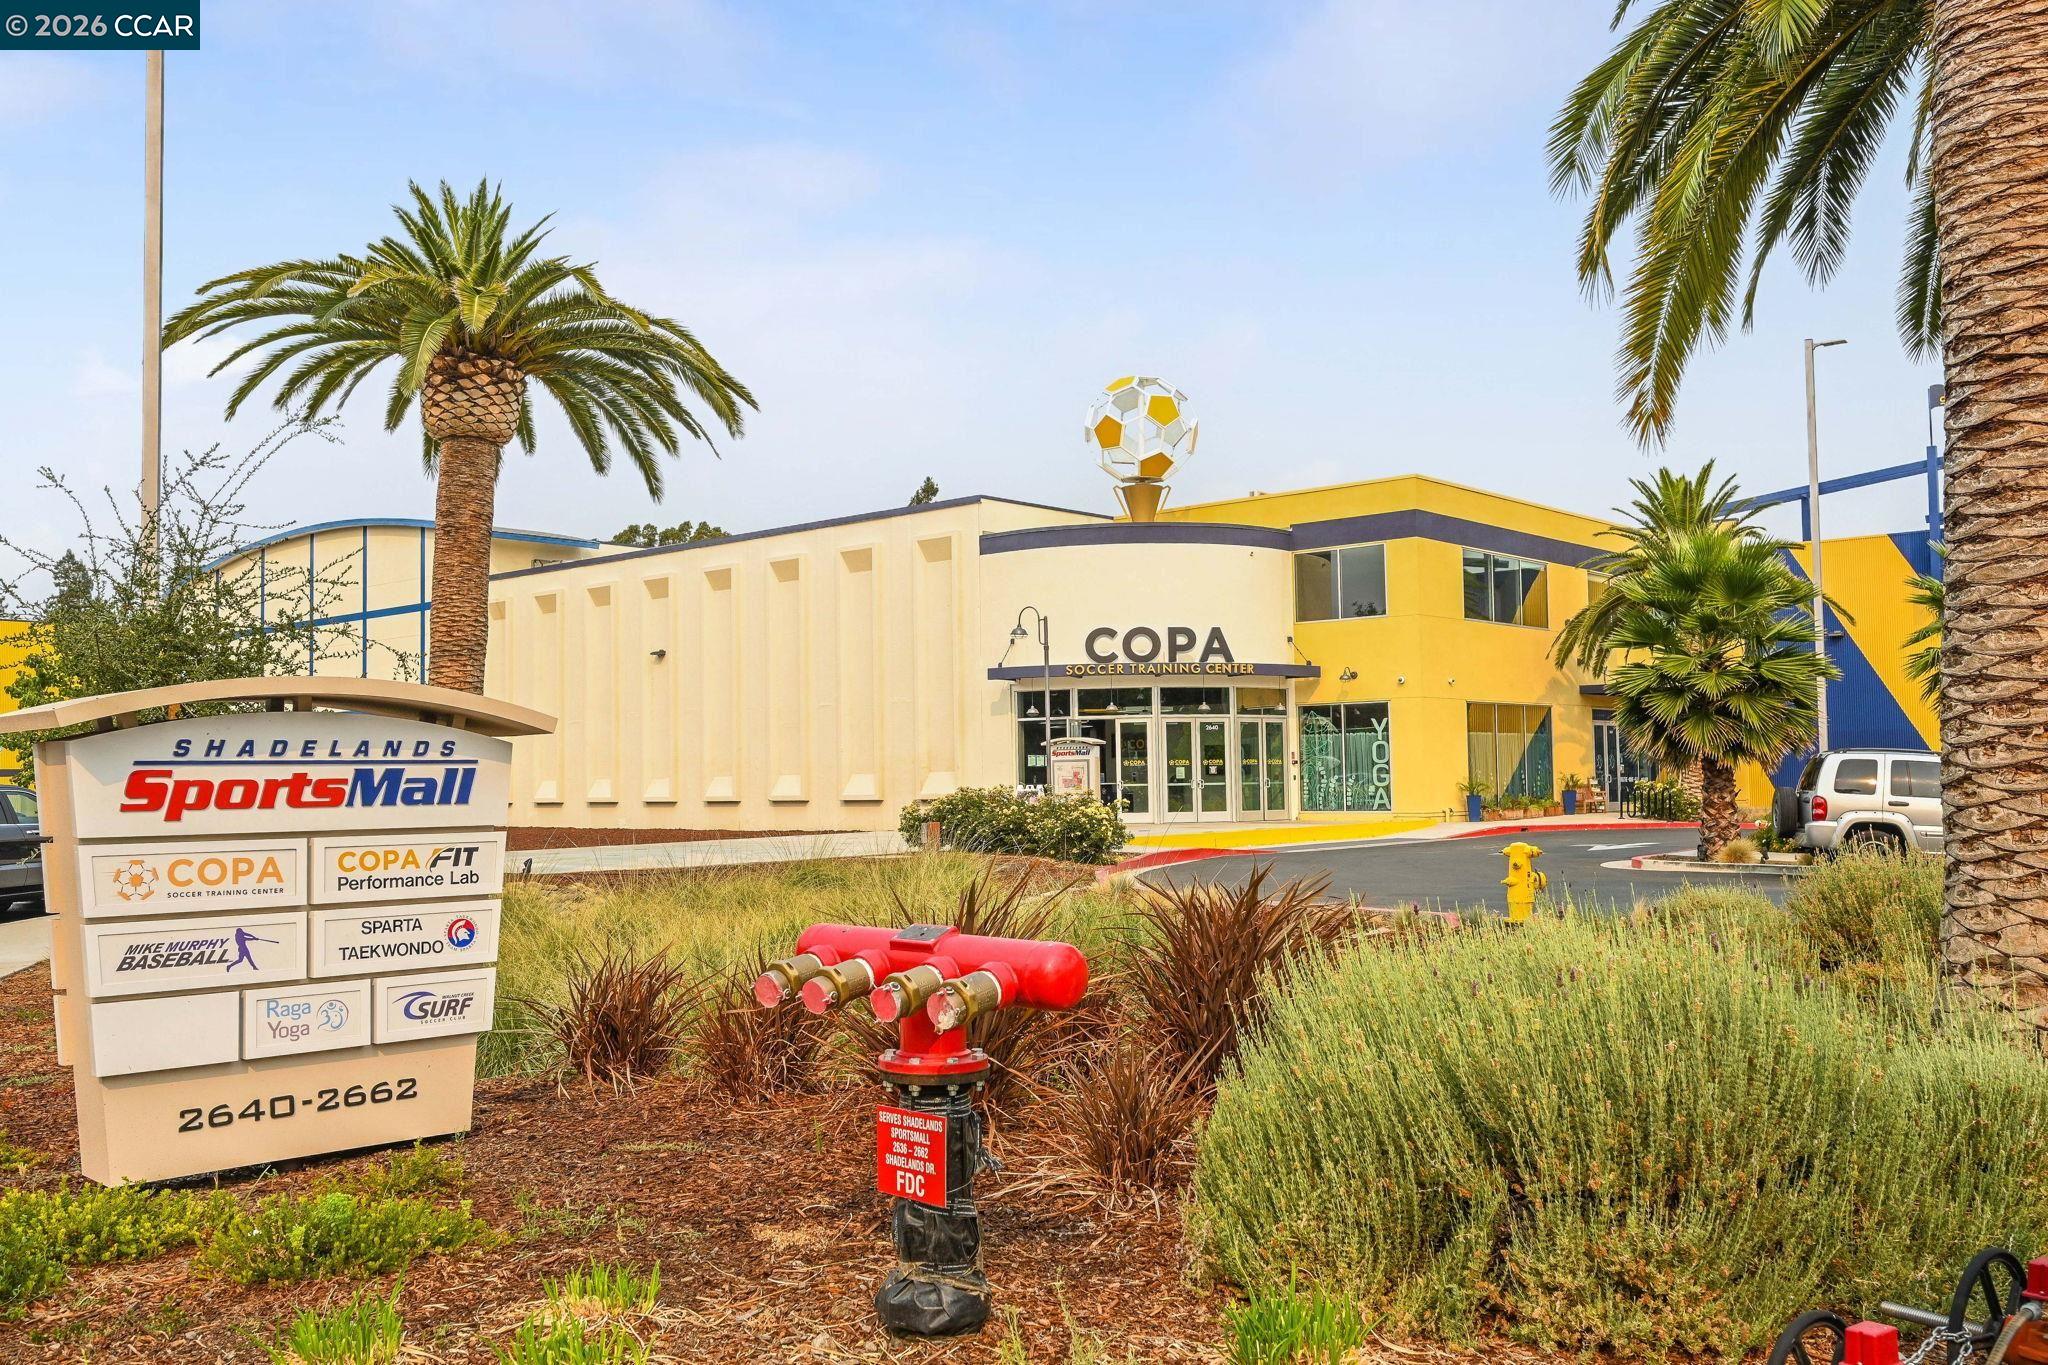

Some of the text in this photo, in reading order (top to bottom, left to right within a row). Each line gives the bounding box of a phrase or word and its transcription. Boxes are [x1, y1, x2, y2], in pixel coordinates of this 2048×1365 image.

[1085, 626, 1235, 664] COPA
[1065, 663, 1255, 676] SOCCER TRAINING CENTER
[173, 739, 456, 758] SHADELANDS
[1051, 749, 1091, 757] SportsMall
[1371, 717, 1391, 810] YOGA
[120, 767, 477, 822] SportsMall
[337, 846, 479, 873] COPA FIT
[167, 856, 284, 887] COPA
[337, 870, 479, 891] Performance Lab
[361, 918, 423, 935] SPARTA
[125, 938, 230, 955] MIKE MURPHY
[339, 940, 444, 961] TAEKWONDO
[116, 949, 230, 972] BASEBALL
[266, 1000, 312, 1020] Raga
[418, 997, 474, 1019] SURF
[267, 1021, 310, 1041] Yoga
[178, 1078, 417, 1133] 2640-2662
[879, 1111, 943, 1132] SERVES SHADELANDS
[890, 1127, 931, 1145] SPORTSMALL
[893, 1142, 908, 1154] 2636
[913, 1146, 929, 1159] 2662
[885, 1154, 937, 1175] SHADELANDS DR.
[896, 1170, 925, 1197] FDC
